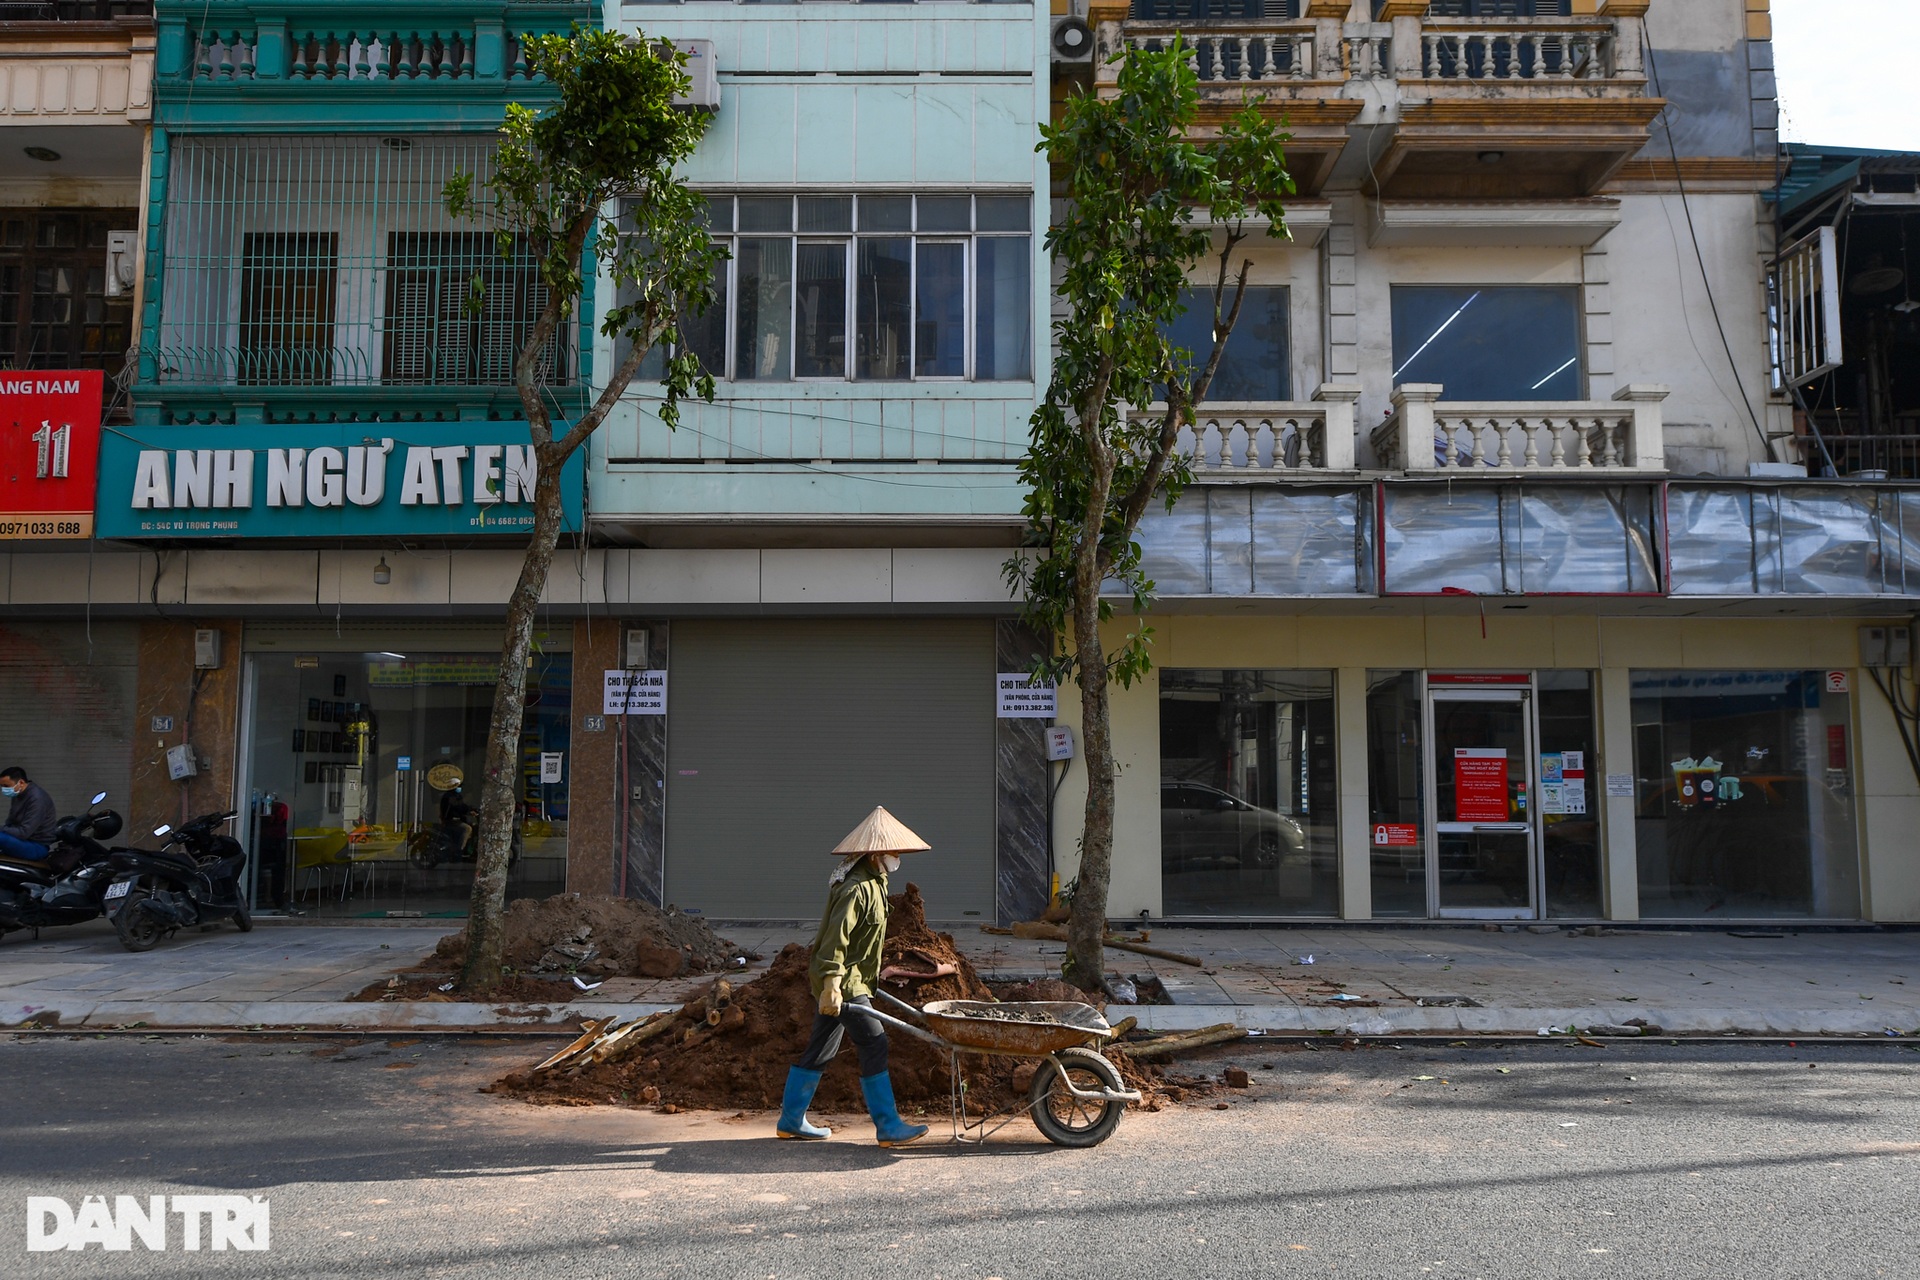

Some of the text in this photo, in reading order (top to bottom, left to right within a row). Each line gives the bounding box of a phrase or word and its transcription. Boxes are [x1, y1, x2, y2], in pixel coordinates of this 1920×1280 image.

[36, 380, 80, 394] NAM
[131, 449, 253, 509] ANH
[57, 522, 80, 535] 688
[186, 521, 211, 531] TRỌNG
[212, 521, 238, 531] PHỤNG
[608, 677, 621, 686] CHO
[650, 675, 663, 686] NHÀ
[1000, 680, 1014, 690] CHO
